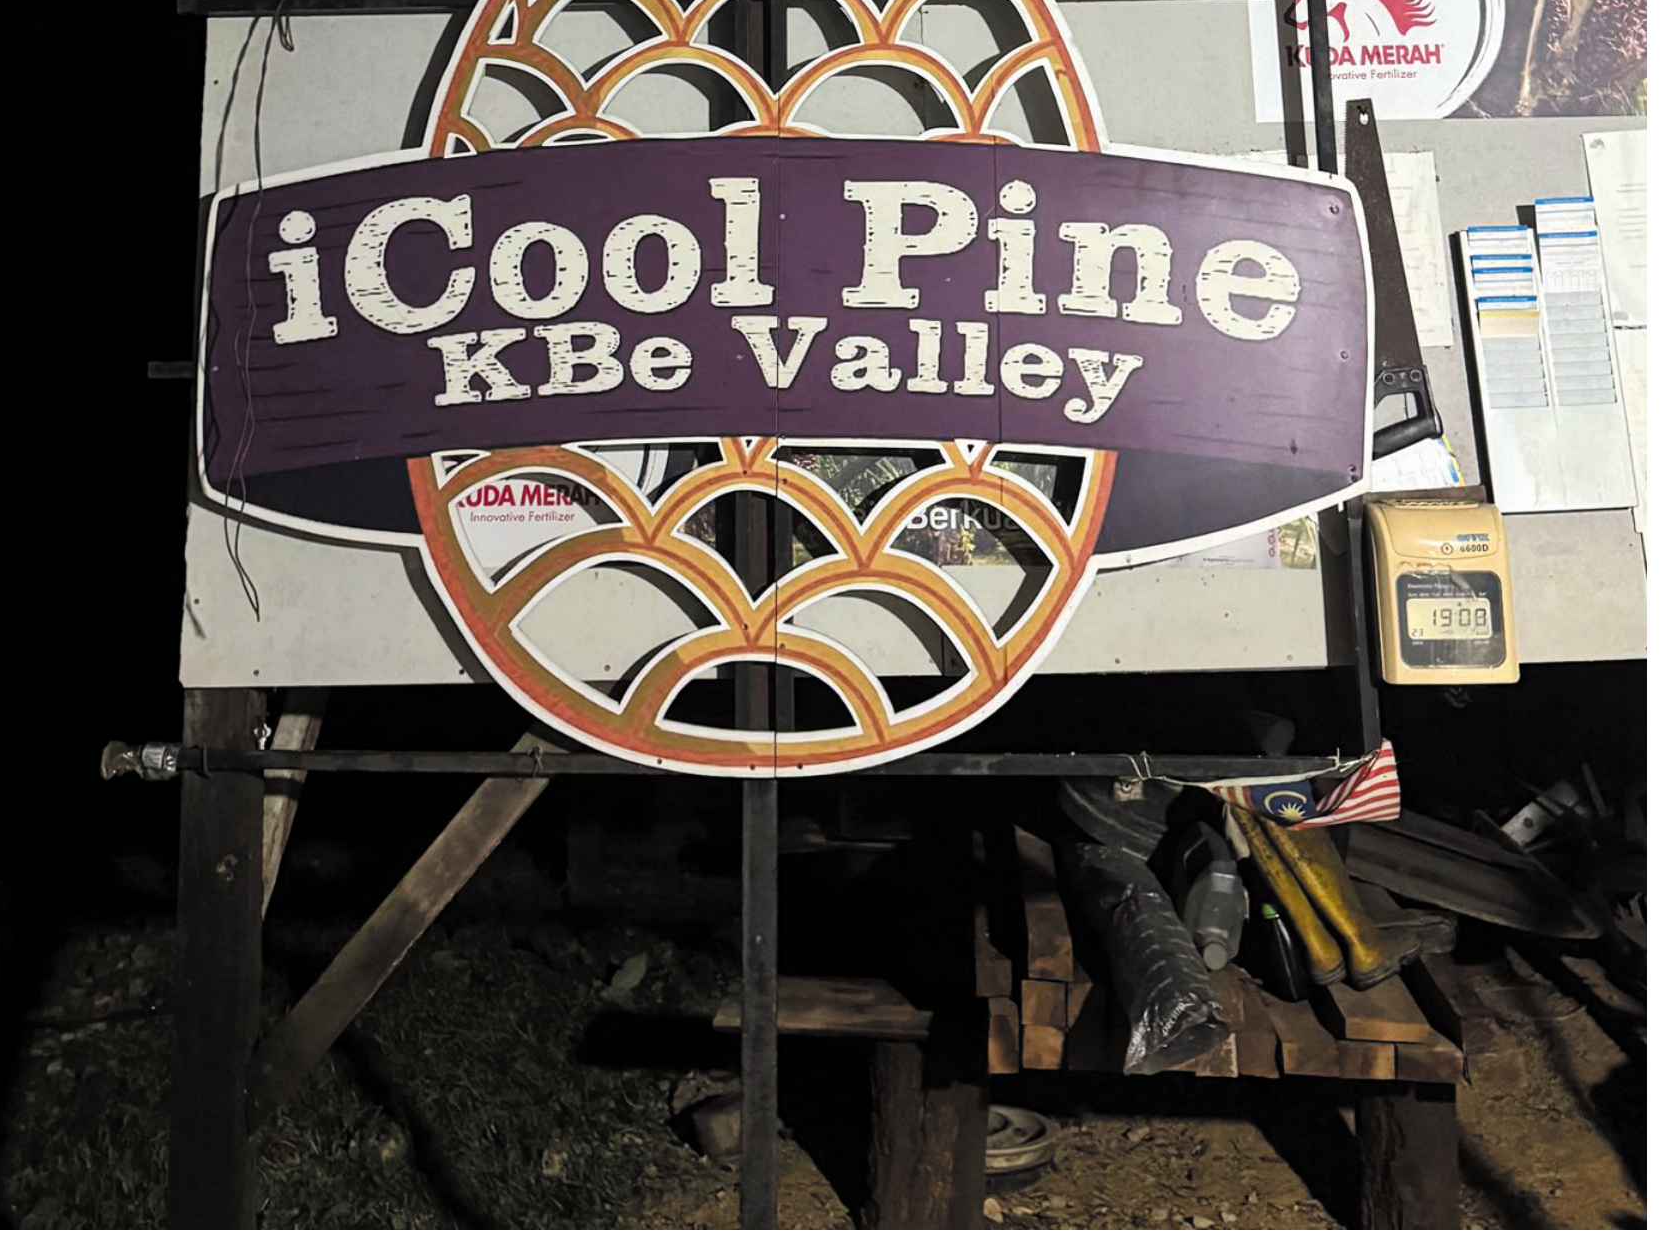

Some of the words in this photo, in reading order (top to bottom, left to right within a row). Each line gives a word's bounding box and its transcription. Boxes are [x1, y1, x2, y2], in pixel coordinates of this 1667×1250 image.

[1360, 43, 1442, 66] MERAH
[1370, 68, 1418, 80] Fertilizer
[265, 175, 777, 345] iCool
[841, 178, 1303, 341] Pine
[427, 320, 694, 407] KBe
[731, 314, 1145, 424] Valley
[470, 511, 525, 523] Innovative
[528, 510, 575, 522] Fertilizer
